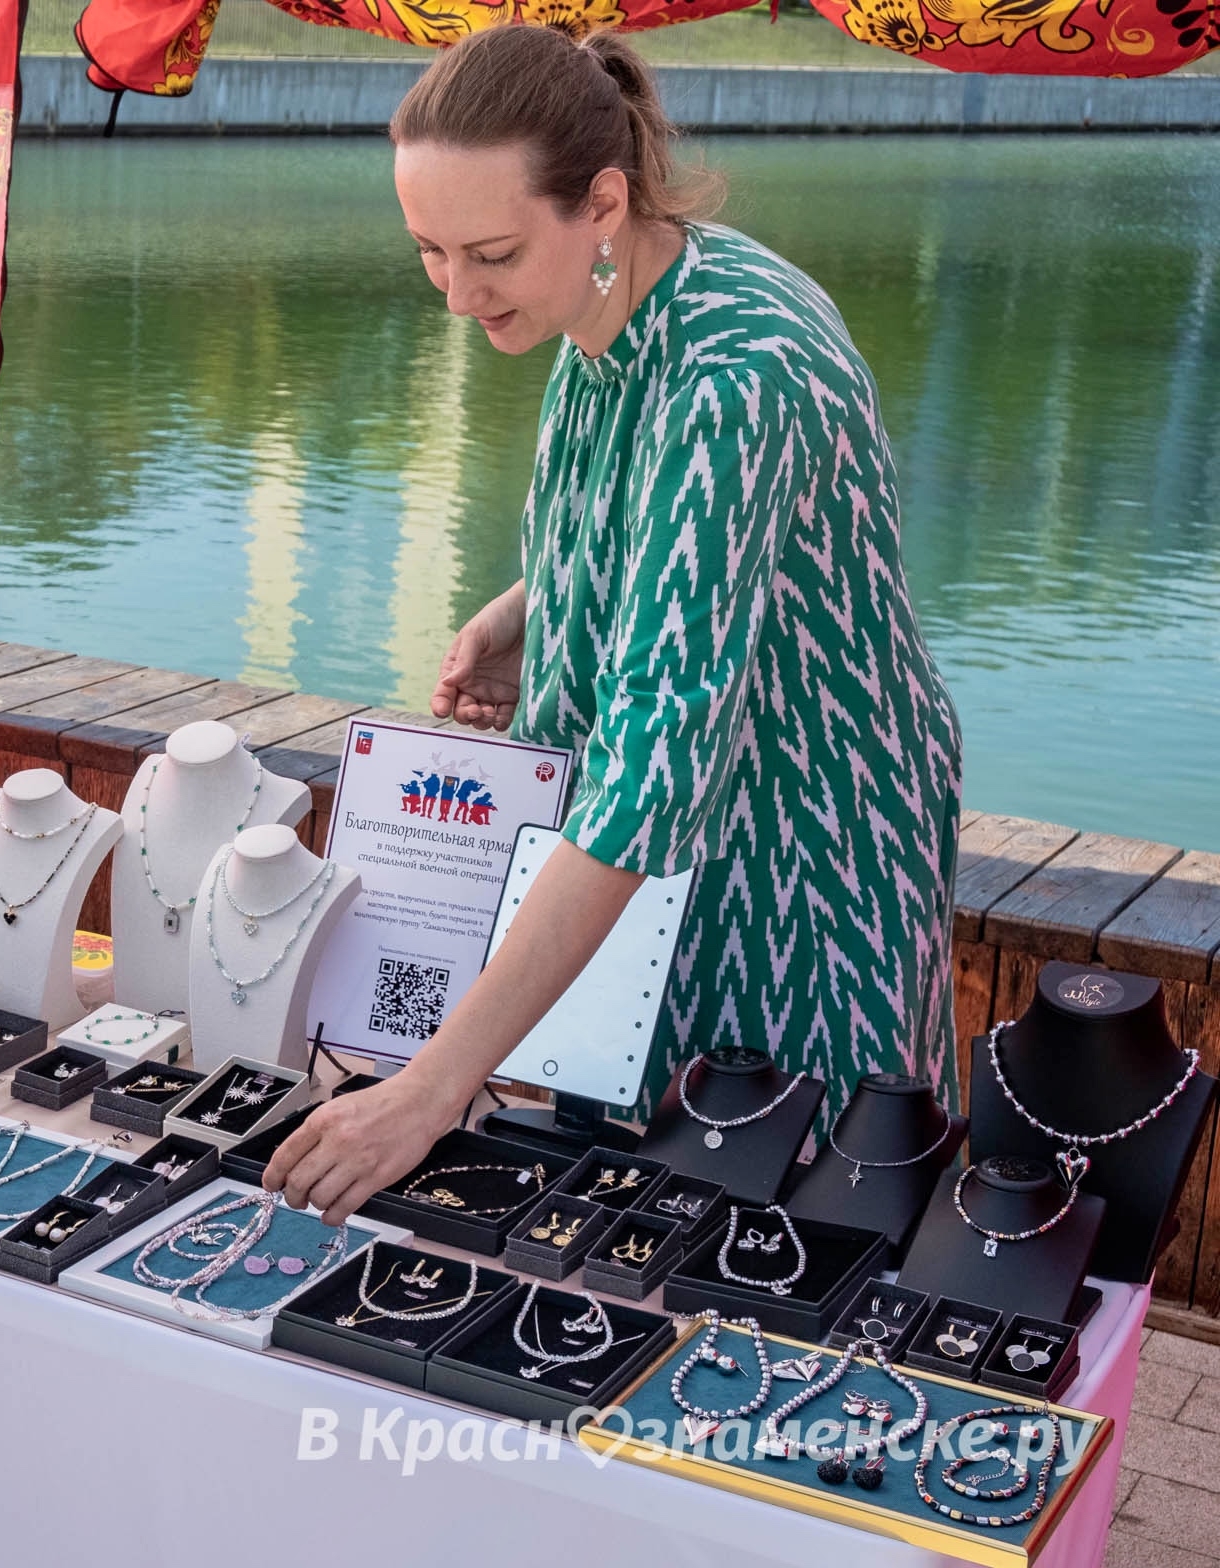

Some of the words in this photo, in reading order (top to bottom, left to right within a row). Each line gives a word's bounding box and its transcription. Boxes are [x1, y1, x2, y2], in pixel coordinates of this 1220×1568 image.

[345, 811, 475, 848] Благотворительная
[478, 838, 513, 856] ярма
[358, 853, 417, 870] специальной
[420, 863, 458, 877] военной
[377, 842, 383, 850] в
[385, 843, 434, 861] поддержку
[434, 852, 492, 868] участников
